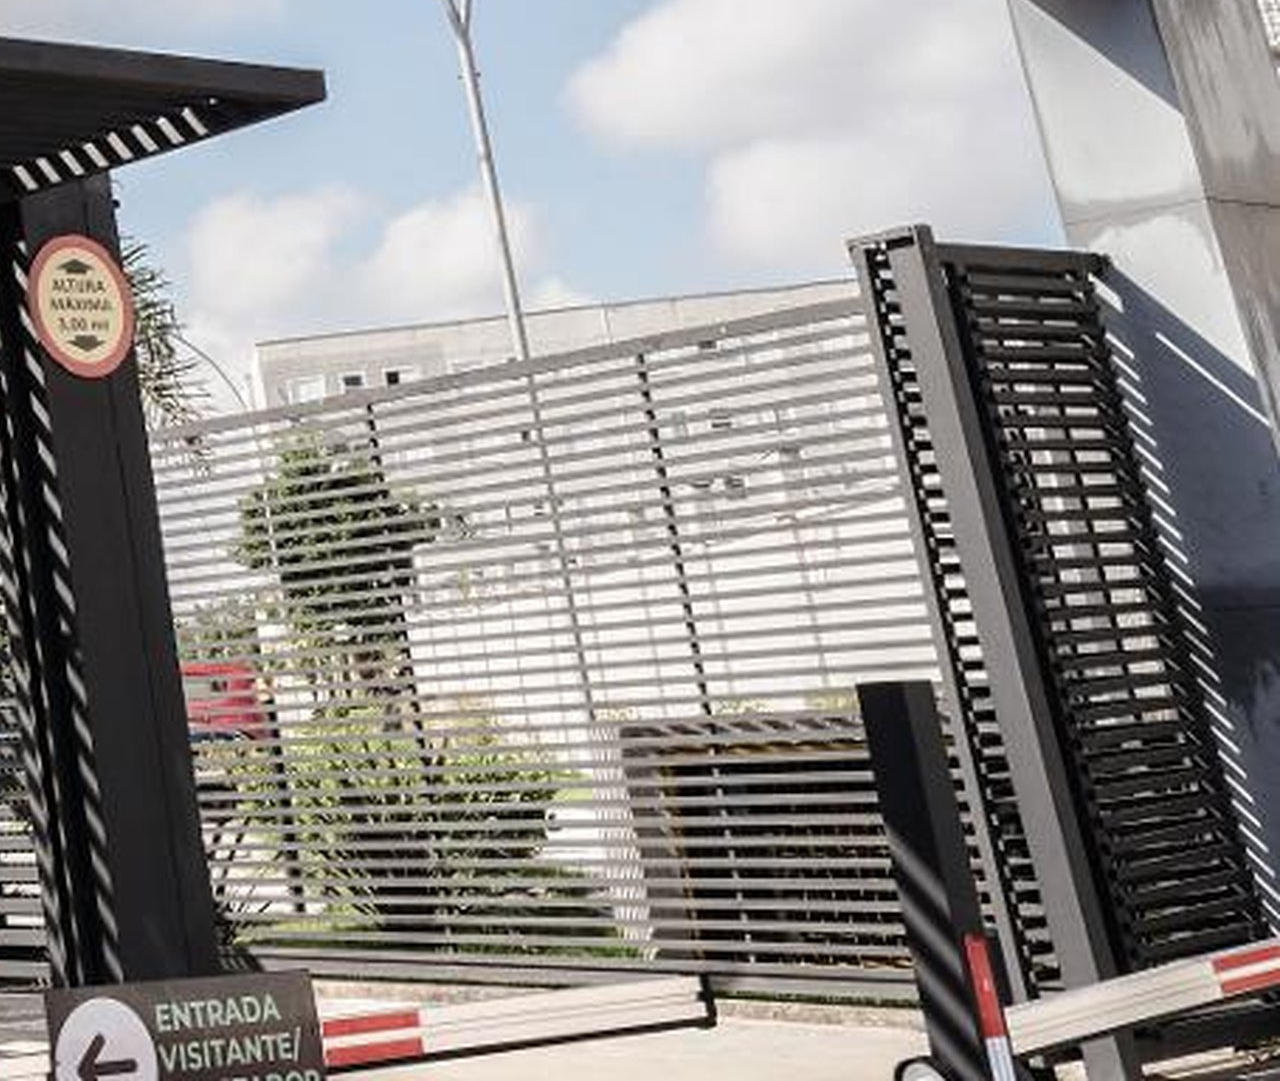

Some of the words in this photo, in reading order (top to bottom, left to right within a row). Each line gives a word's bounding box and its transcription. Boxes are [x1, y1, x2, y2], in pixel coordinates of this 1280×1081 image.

[52, 278, 107, 293] ALTURA
[154, 994, 282, 1032] ENTRADA
[158, 1027, 301, 1073] VISITANTE/
